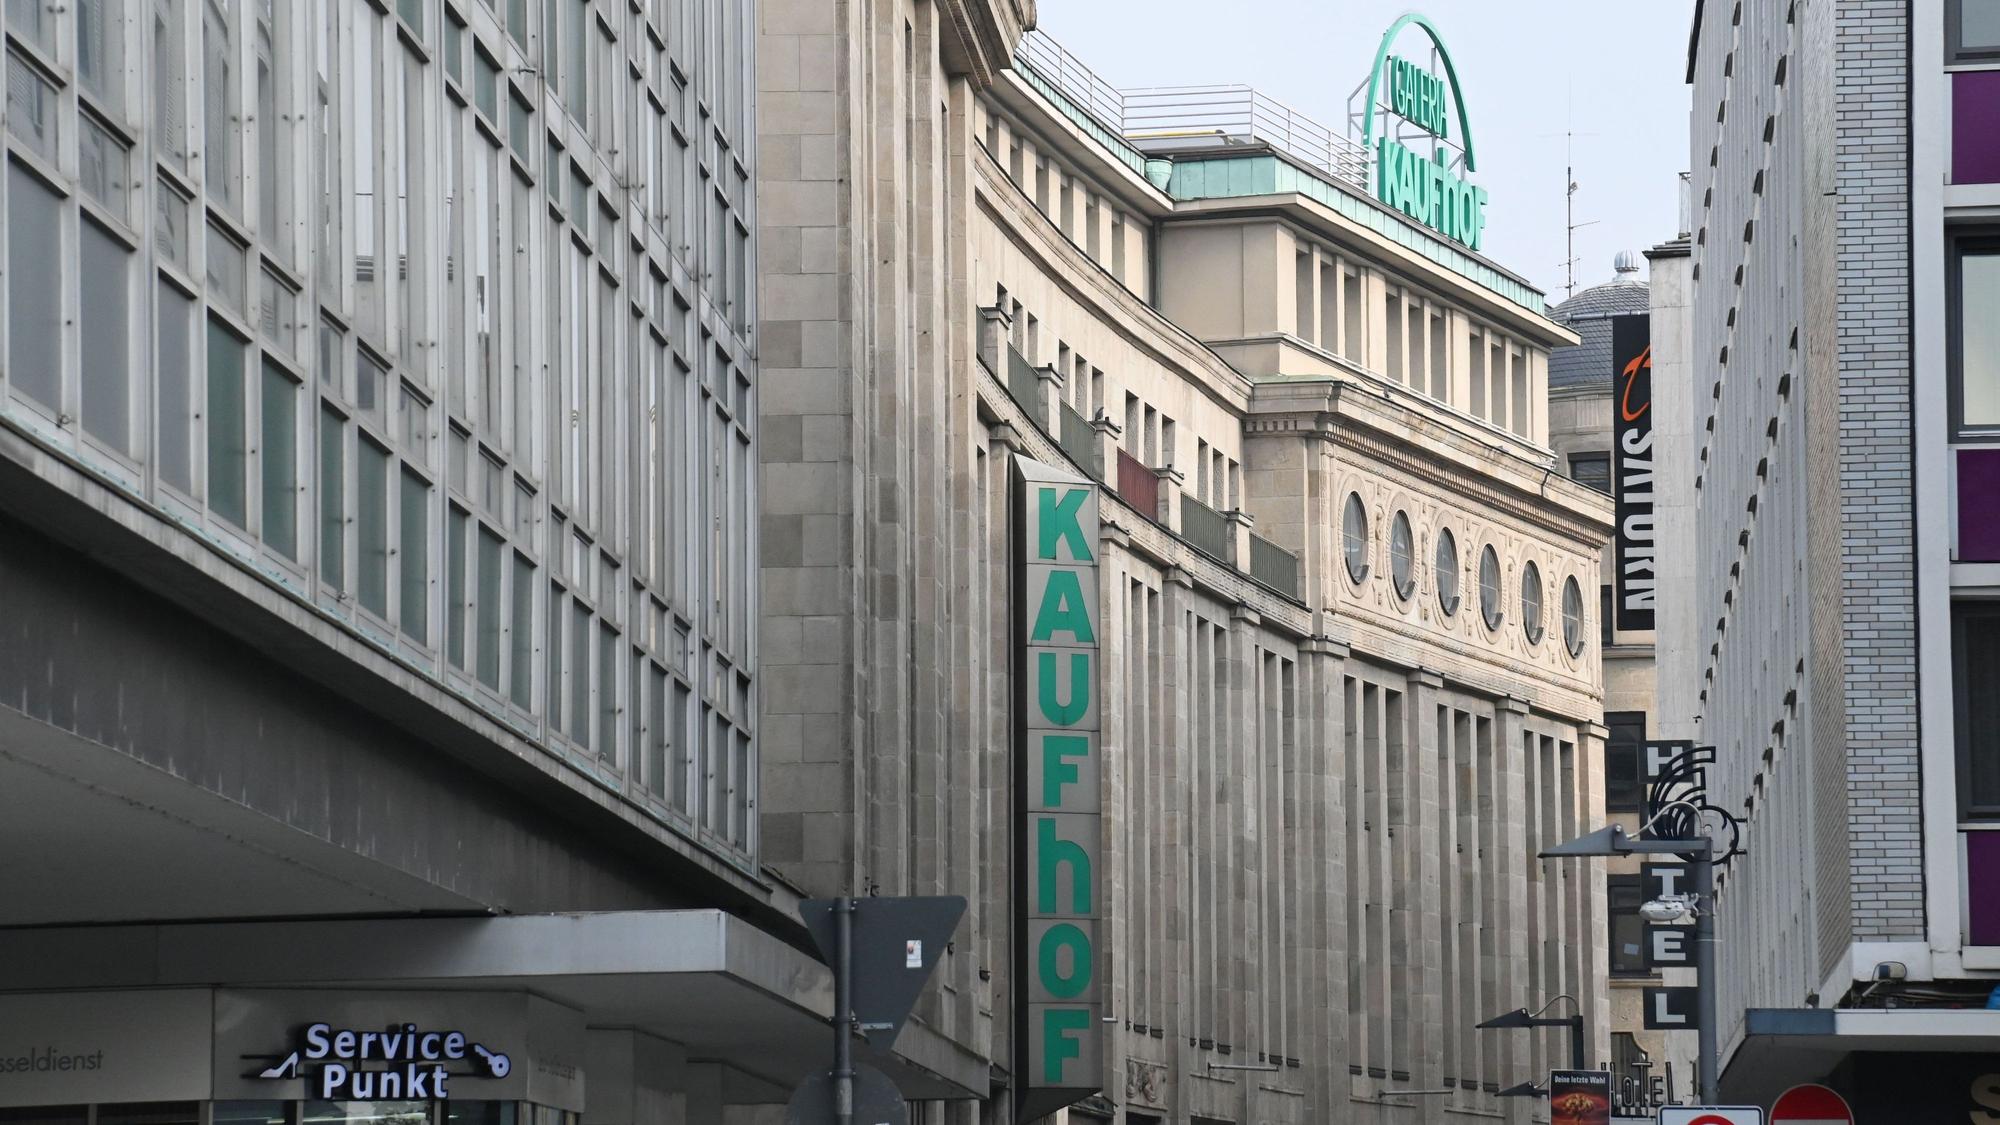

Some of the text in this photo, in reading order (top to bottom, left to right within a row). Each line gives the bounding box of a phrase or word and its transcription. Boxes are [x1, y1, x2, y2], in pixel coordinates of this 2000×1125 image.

[1391, 55, 1448, 139] GALERIA
[306, 1023, 465, 1060] Service
[323, 1063, 448, 1099] Punkt
[1554, 1075, 1606, 1085] Deine letzte Wahl
